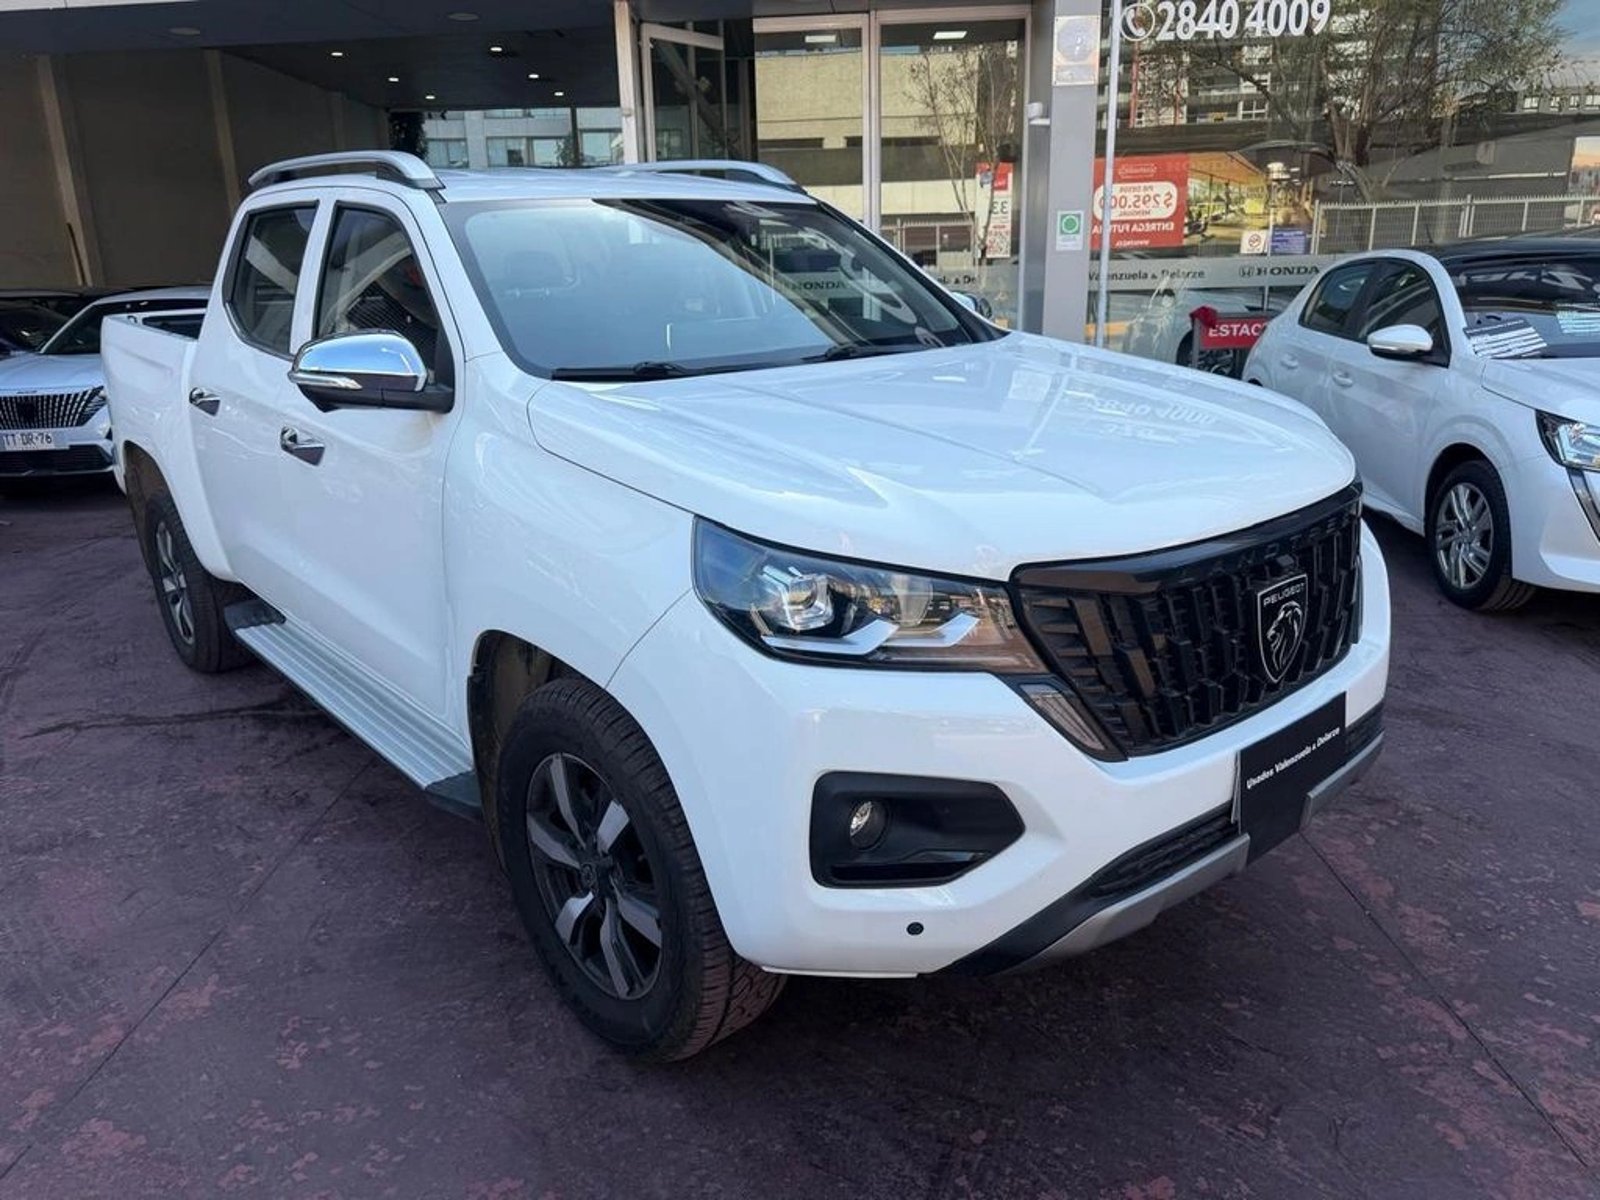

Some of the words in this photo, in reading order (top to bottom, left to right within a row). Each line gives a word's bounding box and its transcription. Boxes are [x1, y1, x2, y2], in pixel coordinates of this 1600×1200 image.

[1156, 0, 1239, 41] 2840
[1244, 0, 1331, 37] 4009
[1255, 265, 1320, 277] HONDA
[1263, 582, 1304, 606] PEUGEOT
